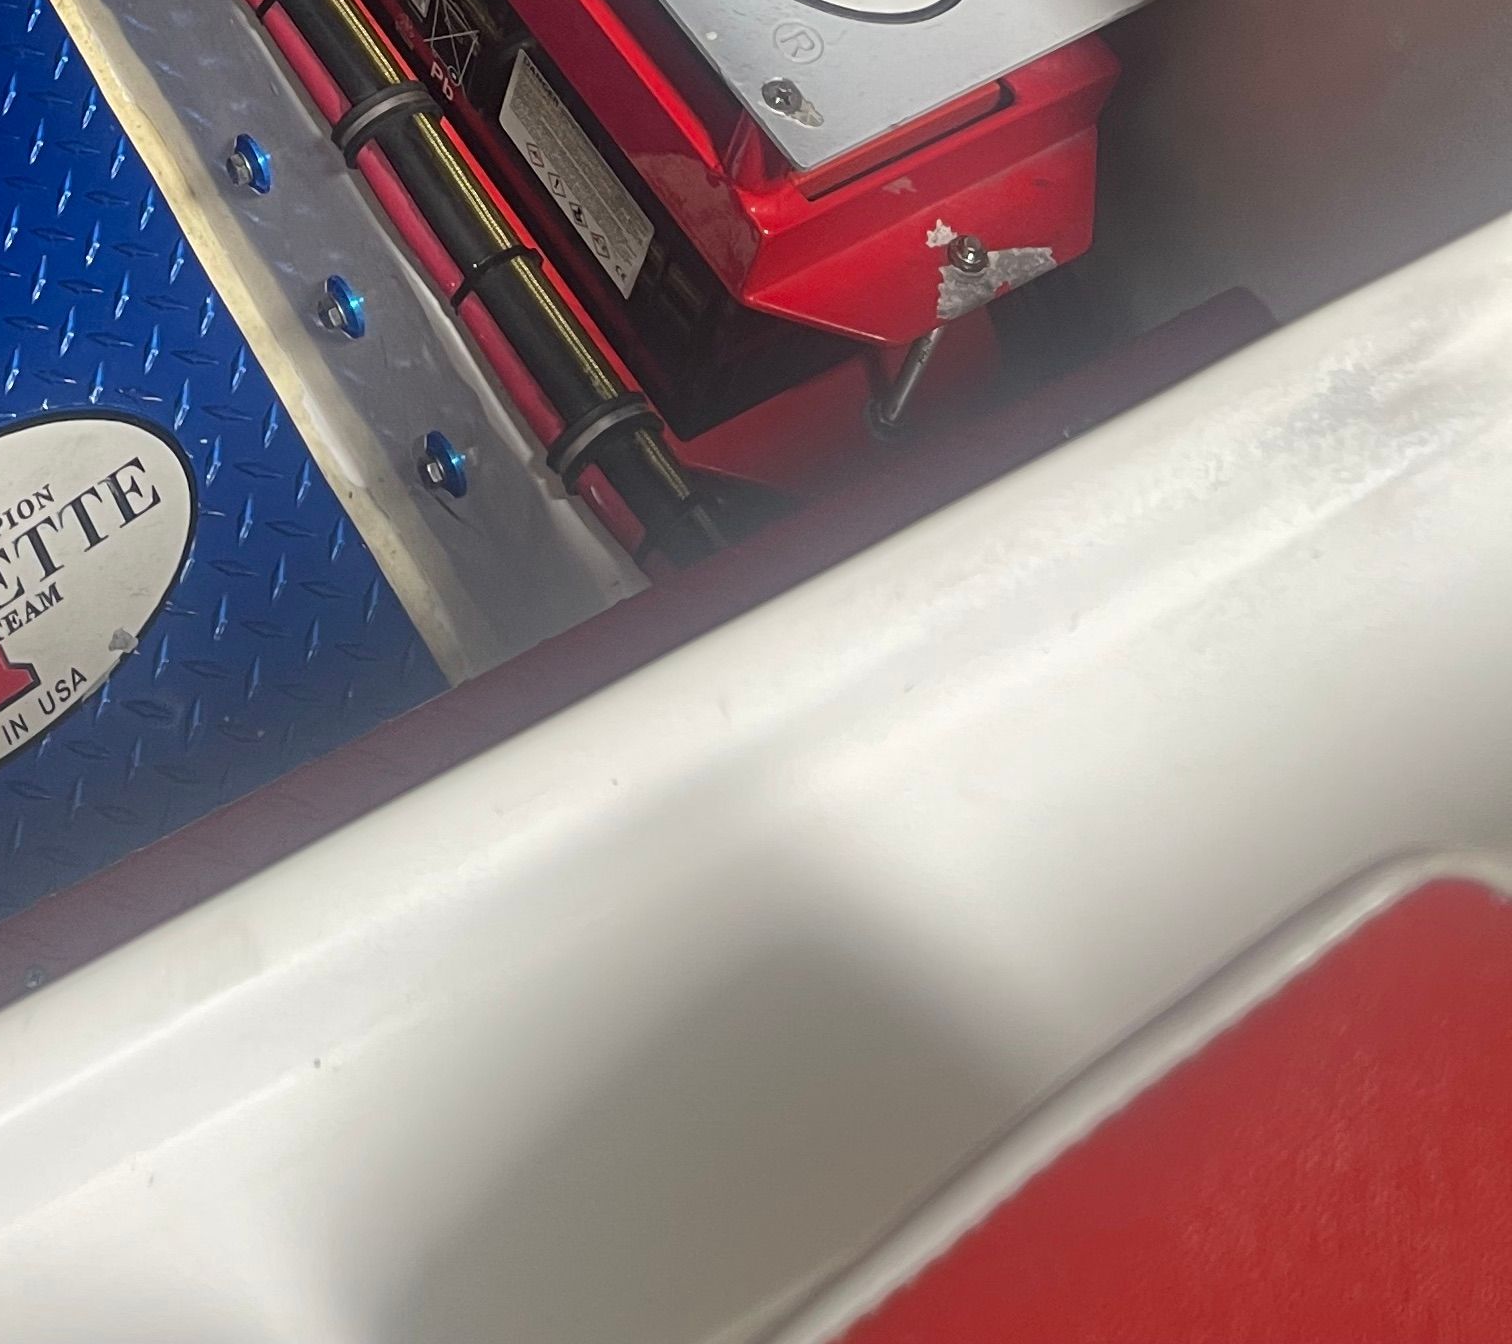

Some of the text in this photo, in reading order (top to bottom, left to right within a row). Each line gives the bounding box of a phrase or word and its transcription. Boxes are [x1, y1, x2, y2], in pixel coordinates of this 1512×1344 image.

[430, 61, 456, 102] Pb
[4, 719, 29, 746] IN
[40, 666, 89, 716] USA
